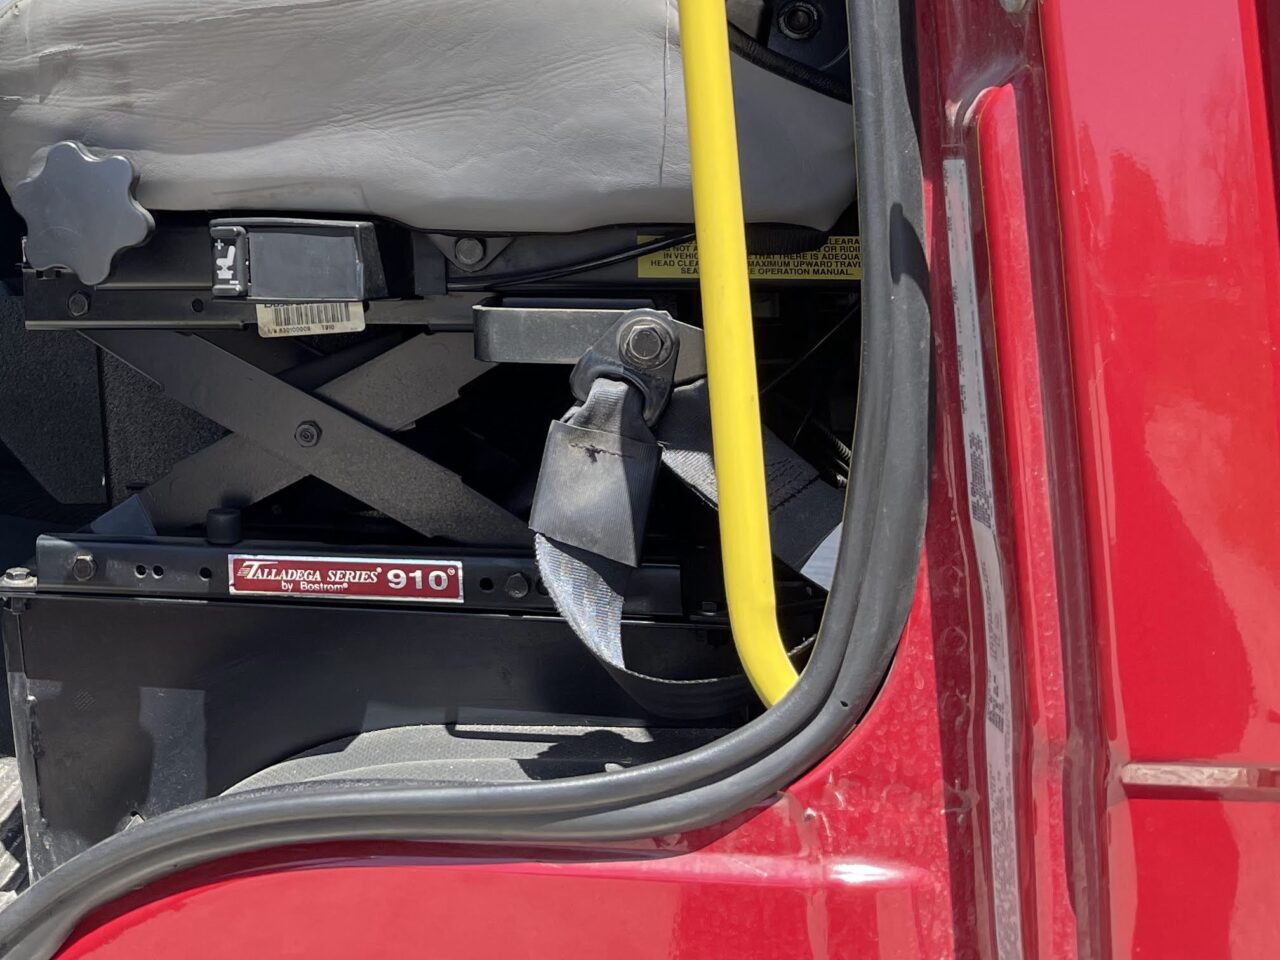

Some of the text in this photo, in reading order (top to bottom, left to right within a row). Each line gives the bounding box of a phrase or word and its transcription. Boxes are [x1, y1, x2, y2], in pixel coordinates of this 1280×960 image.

[650, 259, 675, 267] HEAD
[757, 267, 810, 275] OPERATION
[240, 560, 322, 582] TALLADEGA
[281, 580, 294, 593] by
